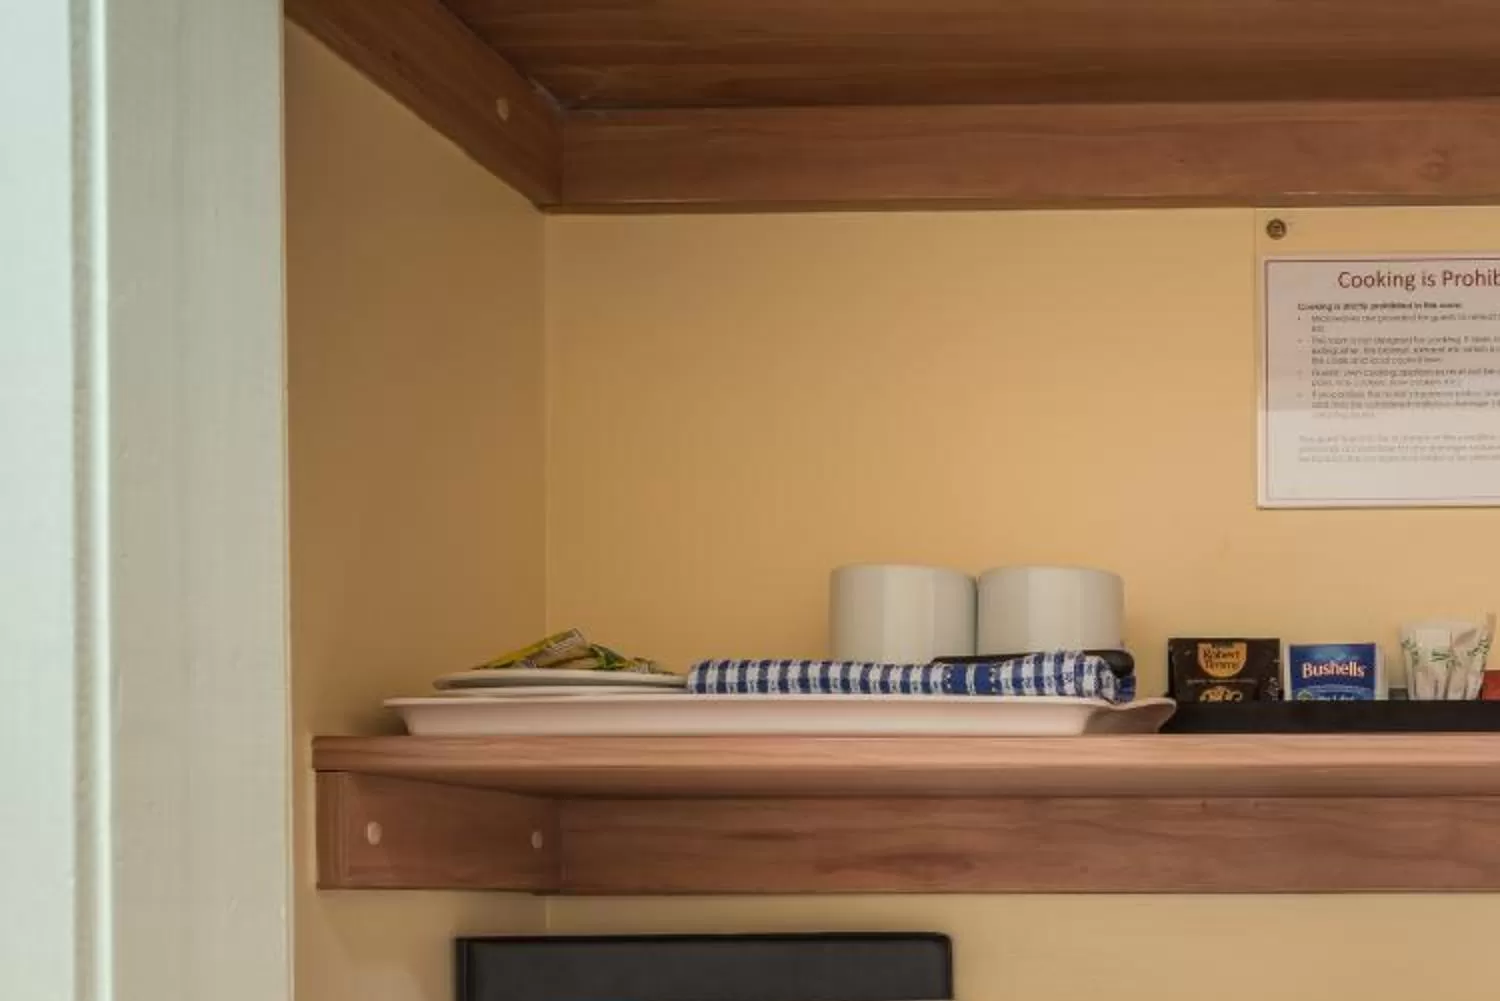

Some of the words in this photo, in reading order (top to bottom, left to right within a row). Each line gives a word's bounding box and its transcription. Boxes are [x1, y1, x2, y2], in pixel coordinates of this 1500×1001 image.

[1338, 270, 1416, 291] Cooking
[1420, 270, 1437, 287] is
[1302, 660, 1365, 679] Bushells
